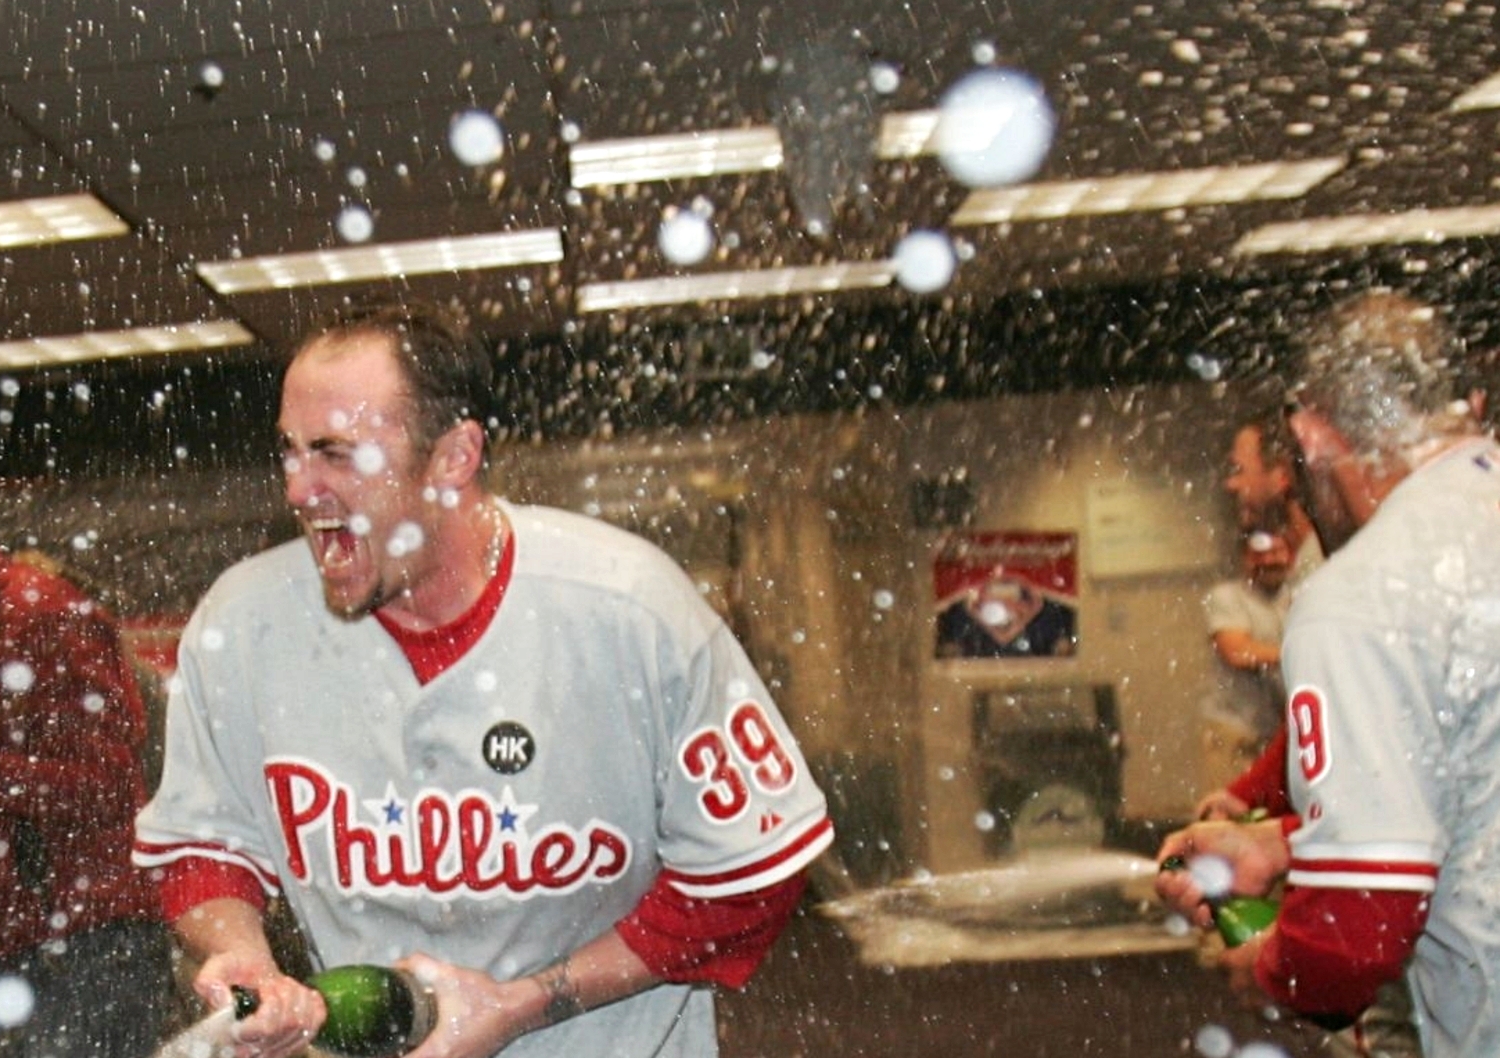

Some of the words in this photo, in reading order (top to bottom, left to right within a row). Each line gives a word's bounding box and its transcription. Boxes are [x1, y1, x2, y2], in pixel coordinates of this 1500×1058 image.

[490, 735, 528, 762] HK
[681, 701, 796, 822] 39
[261, 760, 630, 895] Phillies
